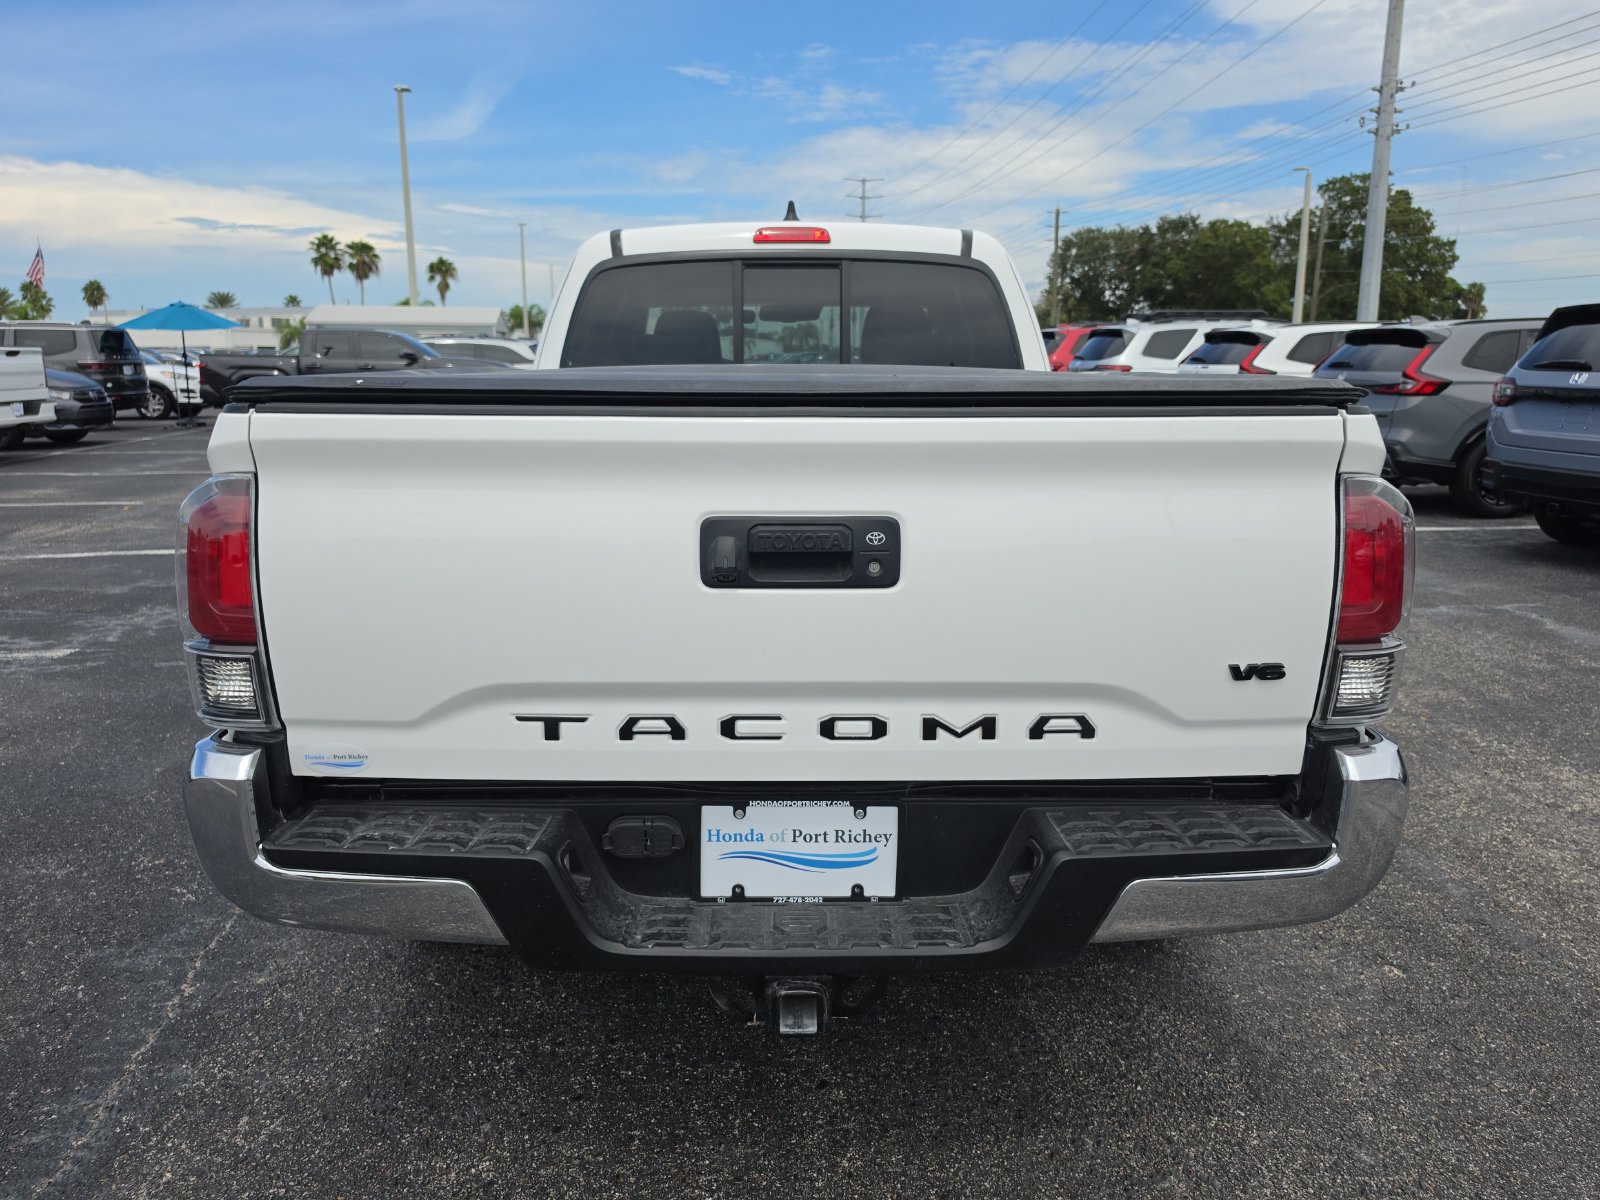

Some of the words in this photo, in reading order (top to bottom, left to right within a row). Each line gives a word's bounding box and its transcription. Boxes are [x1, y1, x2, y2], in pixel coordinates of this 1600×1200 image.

[758, 532, 844, 550] TOYOTA
[1228, 662, 1286, 681] V6
[514, 713, 1096, 740] TACOMA
[706, 828, 765, 843] Honda
[769, 828, 788, 843] of
[791, 829, 829, 843] Port
[834, 829, 892, 847] Richey
